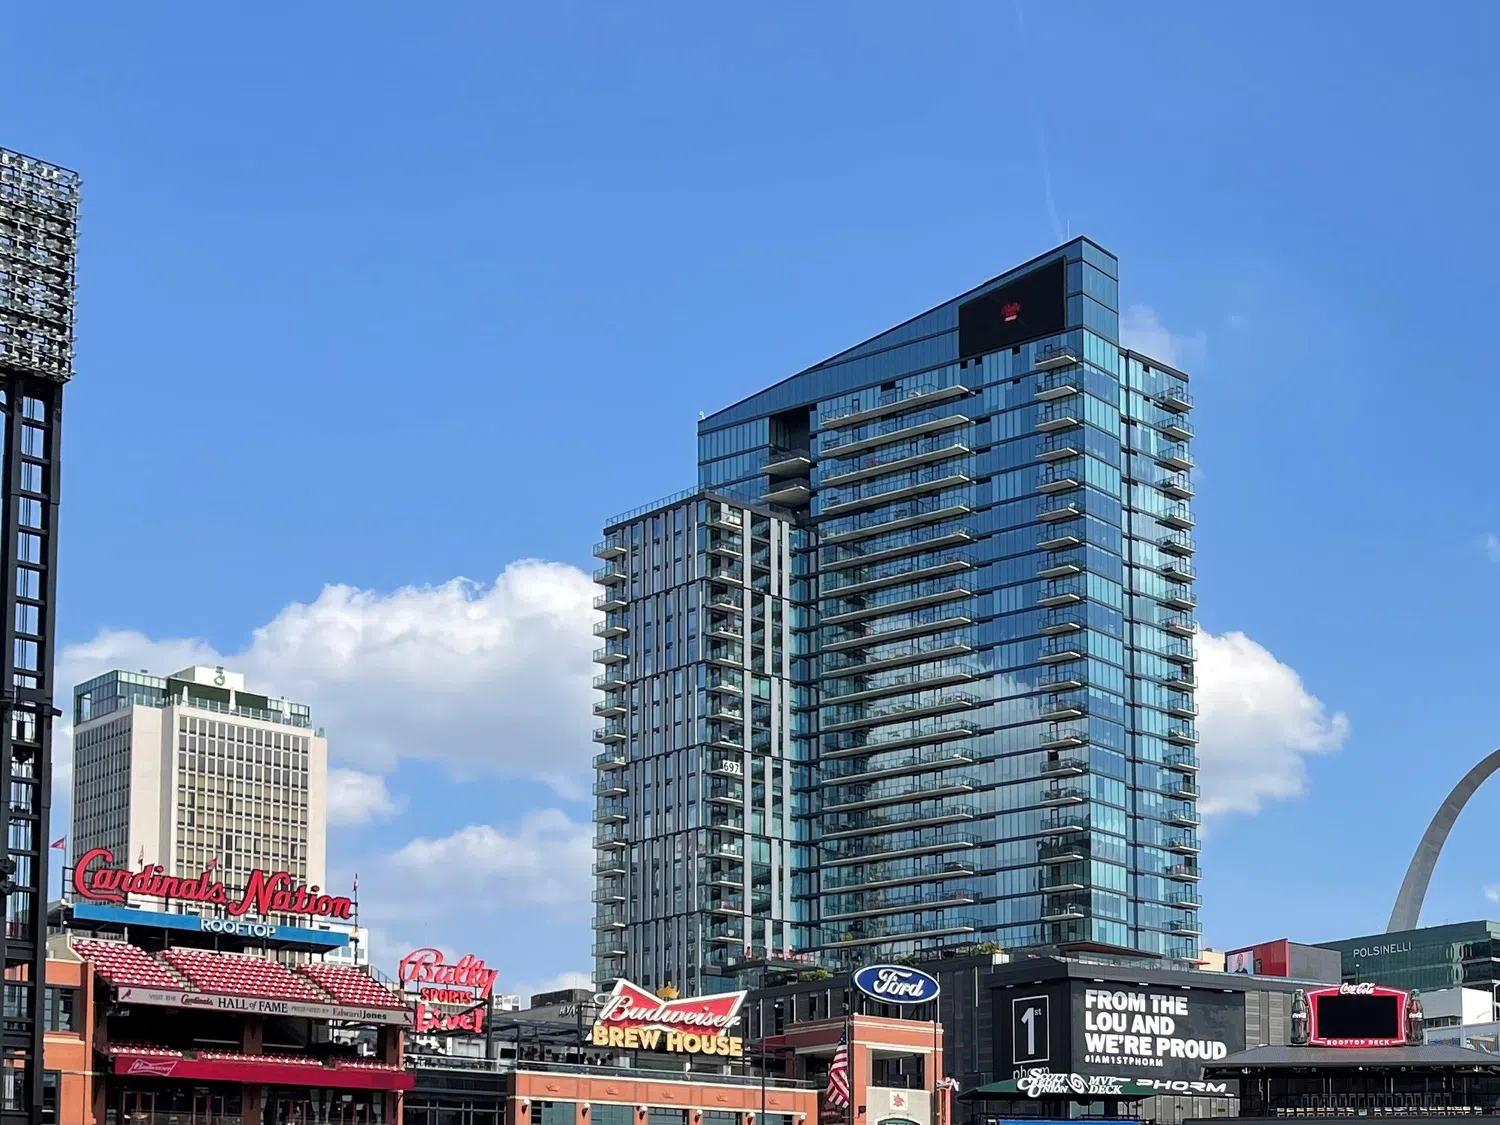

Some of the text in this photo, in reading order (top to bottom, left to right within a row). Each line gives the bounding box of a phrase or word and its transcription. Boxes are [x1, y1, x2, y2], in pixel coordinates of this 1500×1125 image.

[75, 847, 352, 919] Cardinals Nation
[200, 918, 276, 938] ROOFTOP
[1353, 941, 1412, 958] POLSINELLI
[399, 948, 499, 998] Bally
[873, 968, 924, 997] Ford
[420, 987, 474, 1004] SPORTS
[1085, 989, 1188, 1016] FROM THE
[218, 998, 249, 1010] HALL
[249, 1002, 258, 1011] of
[258, 1001, 288, 1014] FAME
[332, 1008, 361, 1018] Edward
[362, 1011, 387, 1020] Jones
[416, 1003, 484, 1034] Live!
[593, 993, 741, 1028] Budweiser
[1085, 1011, 1175, 1035] LOU AND
[593, 1024, 744, 1057] BREW HOUSE
[1084, 1032, 1227, 1060] WE'RE PROUD
[1084, 1055, 1164, 1067] #IAM1STPHORM
[1088, 1076, 1117, 1084] MVP
[1088, 1084, 1123, 1094] DECK
